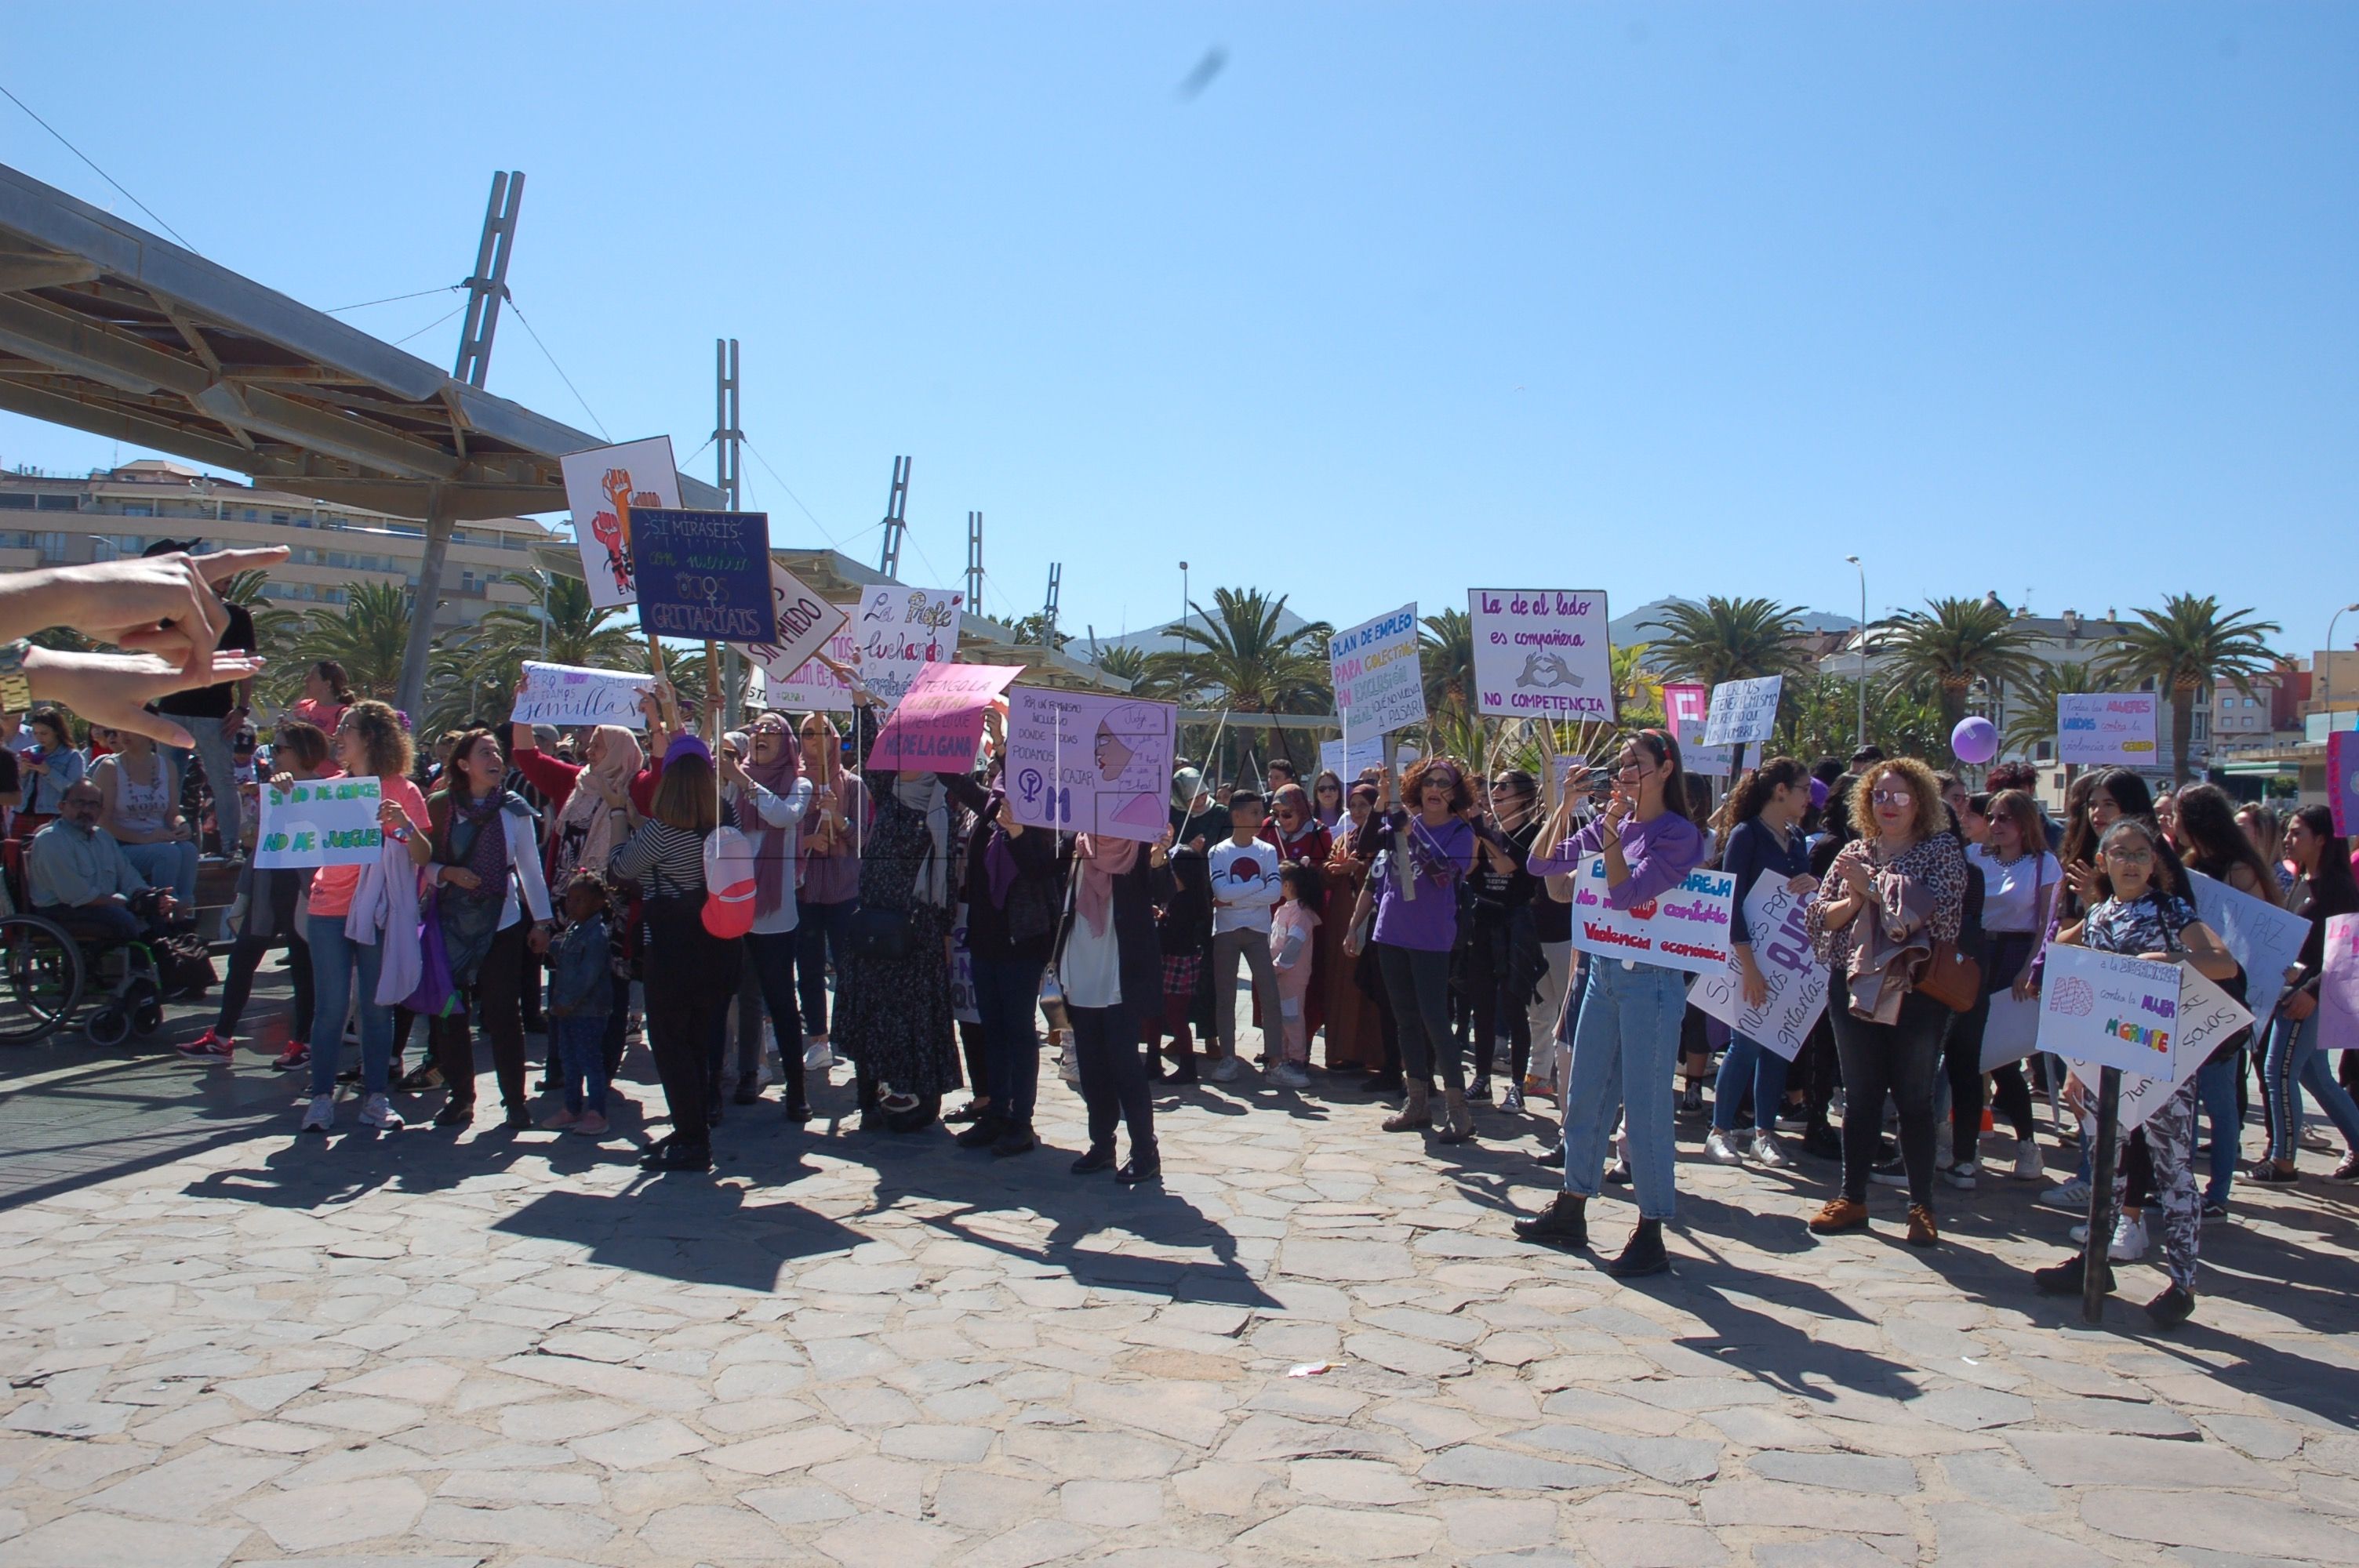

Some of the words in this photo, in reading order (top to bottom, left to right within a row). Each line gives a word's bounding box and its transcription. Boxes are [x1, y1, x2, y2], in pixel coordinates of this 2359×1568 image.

[863, 593, 895, 622] La
[1481, 591, 1502, 615] La
[1510, 593, 1528, 615] de
[1532, 593, 1550, 615] al
[1556, 592, 1591, 615] lado
[863, 630, 943, 662] luchando
[1333, 636, 1357, 659] PLAN
[1361, 630, 1372, 647] DE
[1375, 613, 1412, 641] EMPLEO
[1490, 631, 1507, 644] es
[1514, 629, 1585, 652] compañera
[1335, 659, 1362, 685] PARA
[924, 680, 968, 692] TENGO
[967, 681, 992, 691] LA
[1337, 688, 1352, 708] EN
[516, 688, 637, 720] semillas
[1484, 691, 1502, 706] NO
[1511, 693, 1605, 712] COMPETENCIA
[1018, 728, 1046, 742] DONDE
[1012, 744, 1056, 763] PODAMOS
[1048, 767, 1096, 790] ENCAJAR
[291, 786, 310, 804] NO
[315, 785, 333, 800] ME
[263, 832, 289, 852] NO
[292, 831, 316, 853] ME
[1678, 871, 1732, 898] AREJA
[1583, 920, 1651, 951] Violencia
[1659, 943, 1727, 963] económica
[2049, 975, 2093, 1017] NO
[2099, 989, 2126, 1004] contra
[2128, 991, 2136, 1004] la
[2141, 993, 2175, 1019] MUJER
